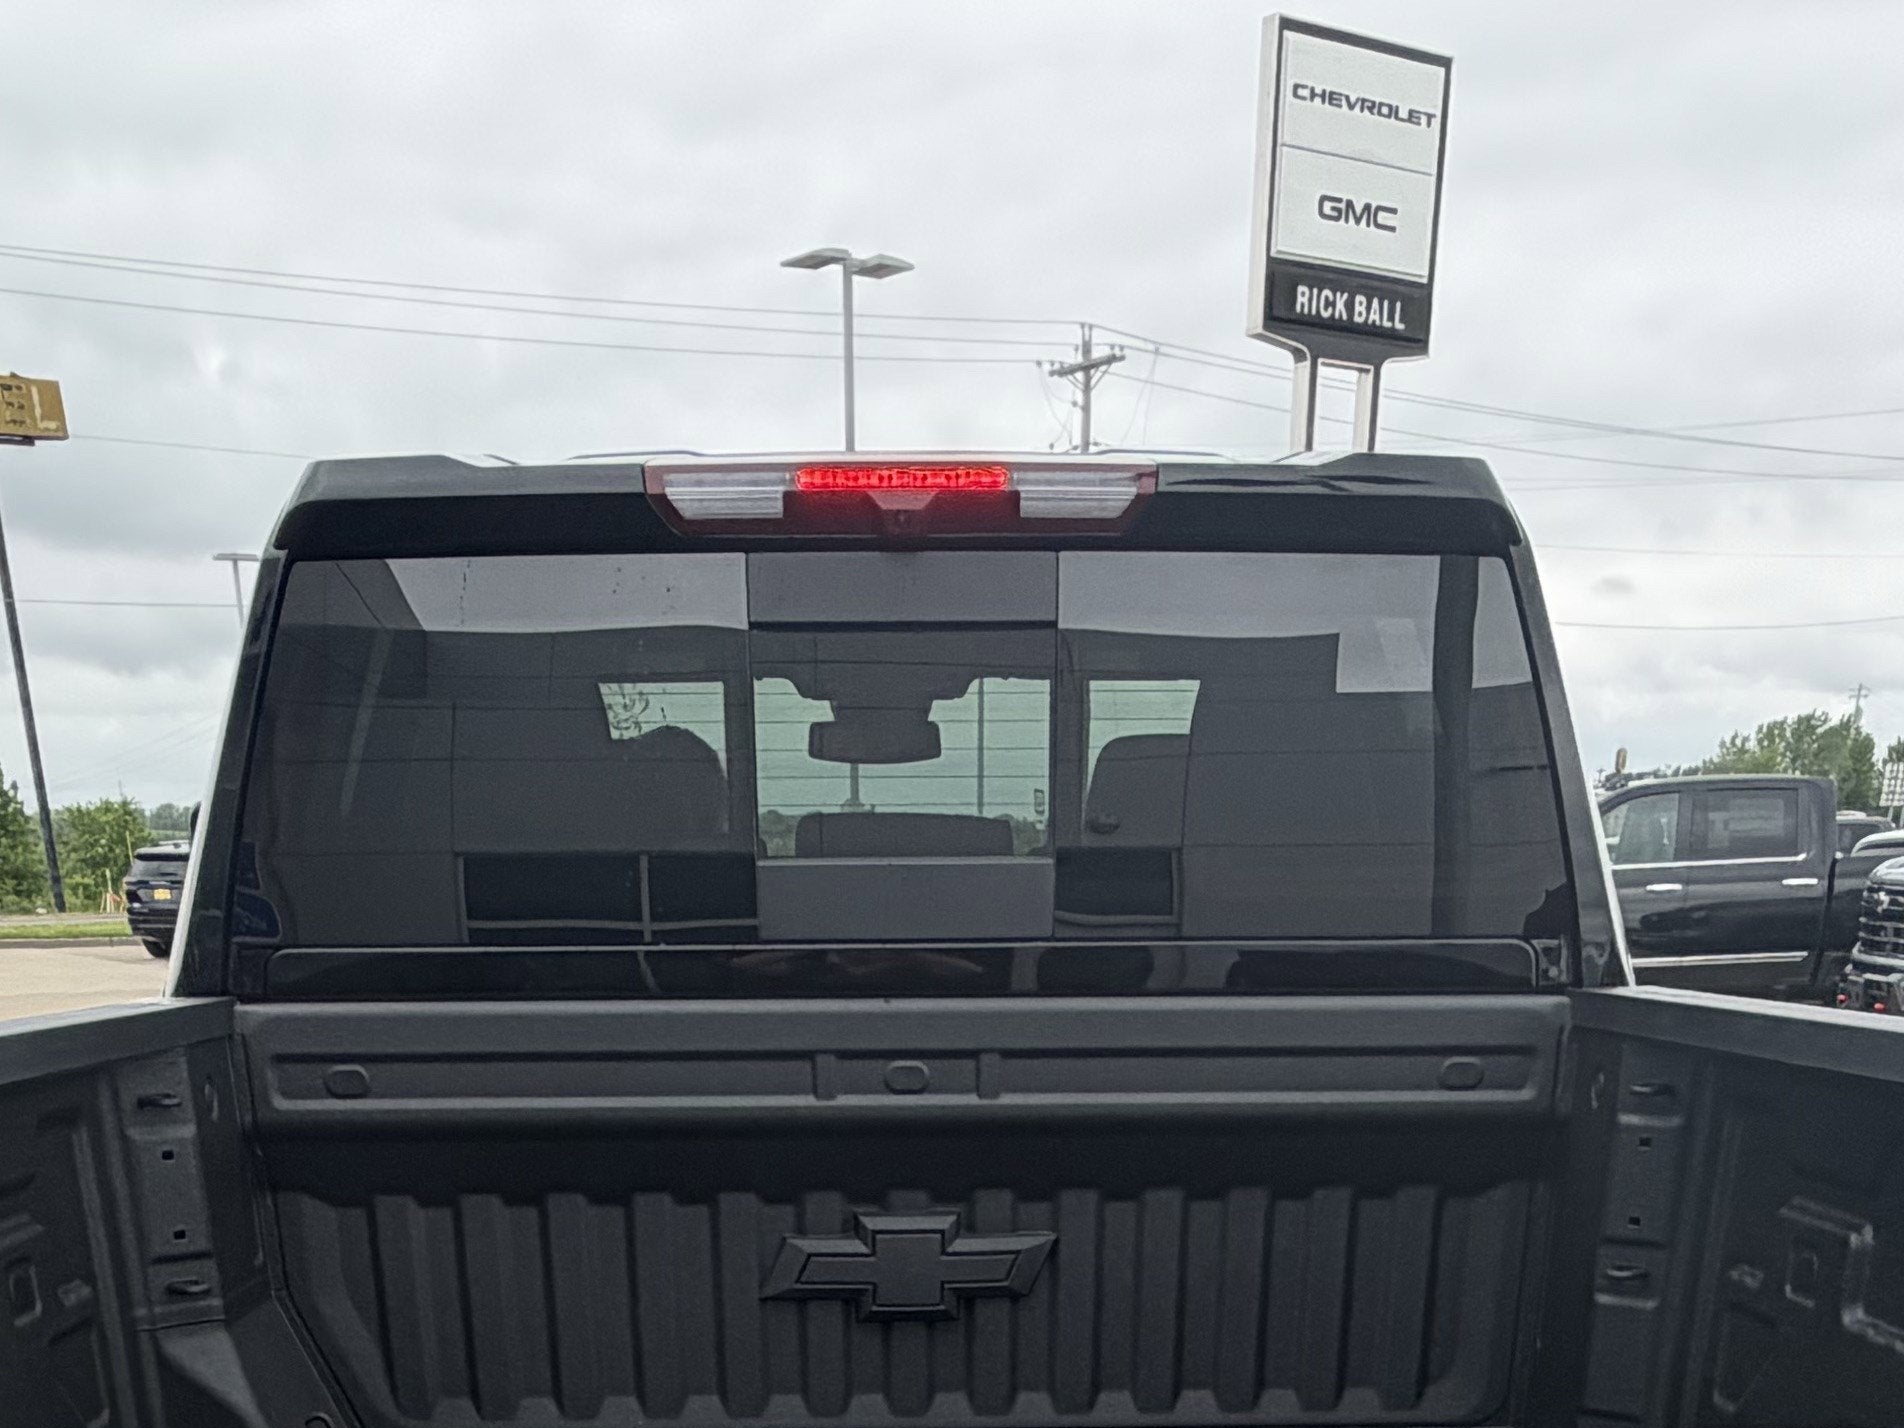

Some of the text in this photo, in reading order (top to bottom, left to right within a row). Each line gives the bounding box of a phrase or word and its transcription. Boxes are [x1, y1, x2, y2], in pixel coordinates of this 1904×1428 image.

[1291, 82, 1437, 130] CHEVROLET
[1317, 194, 1399, 234] GMC
[1295, 284, 1406, 331] RICK BALL
